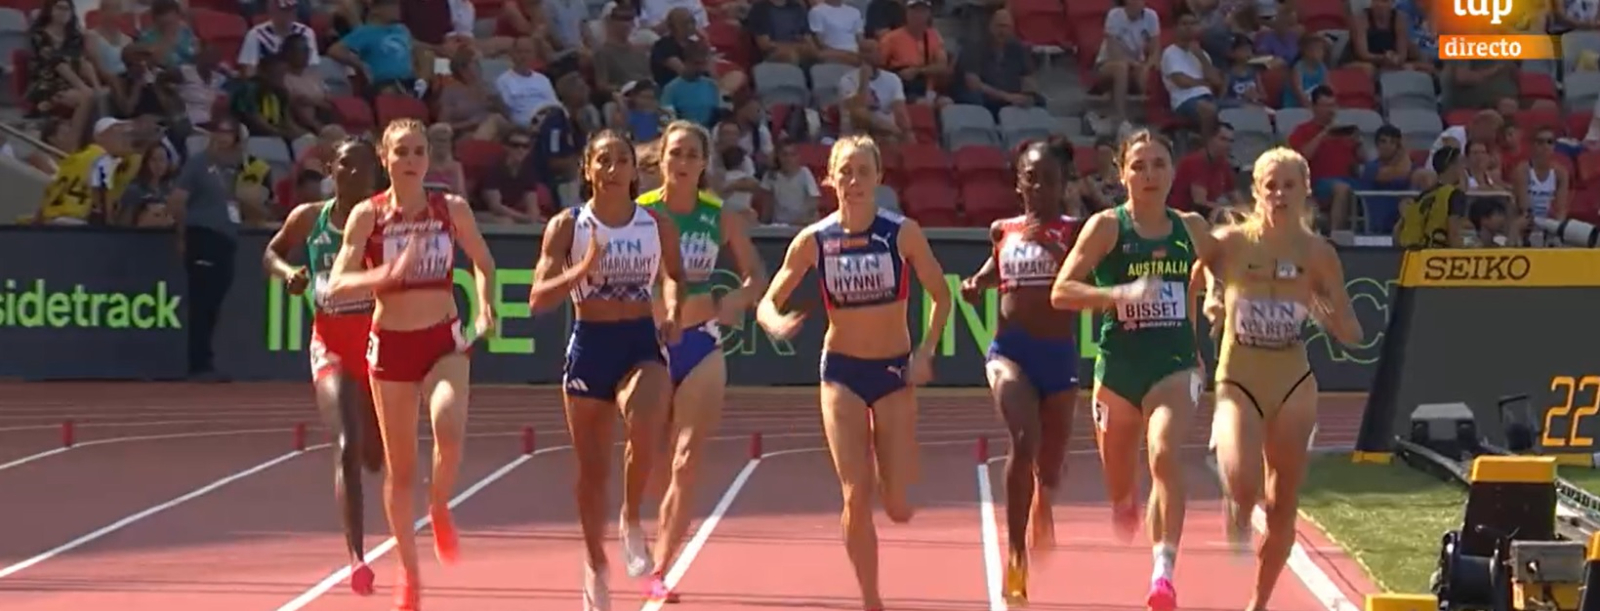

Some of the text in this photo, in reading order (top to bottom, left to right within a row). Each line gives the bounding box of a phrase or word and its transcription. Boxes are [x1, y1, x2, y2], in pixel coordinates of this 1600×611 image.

[1127, 259, 1189, 277] AUSTRALIA
[1424, 255, 1531, 281] SEIKO
[833, 273, 885, 291] HYNNE
[1126, 301, 1178, 319] BISSET
